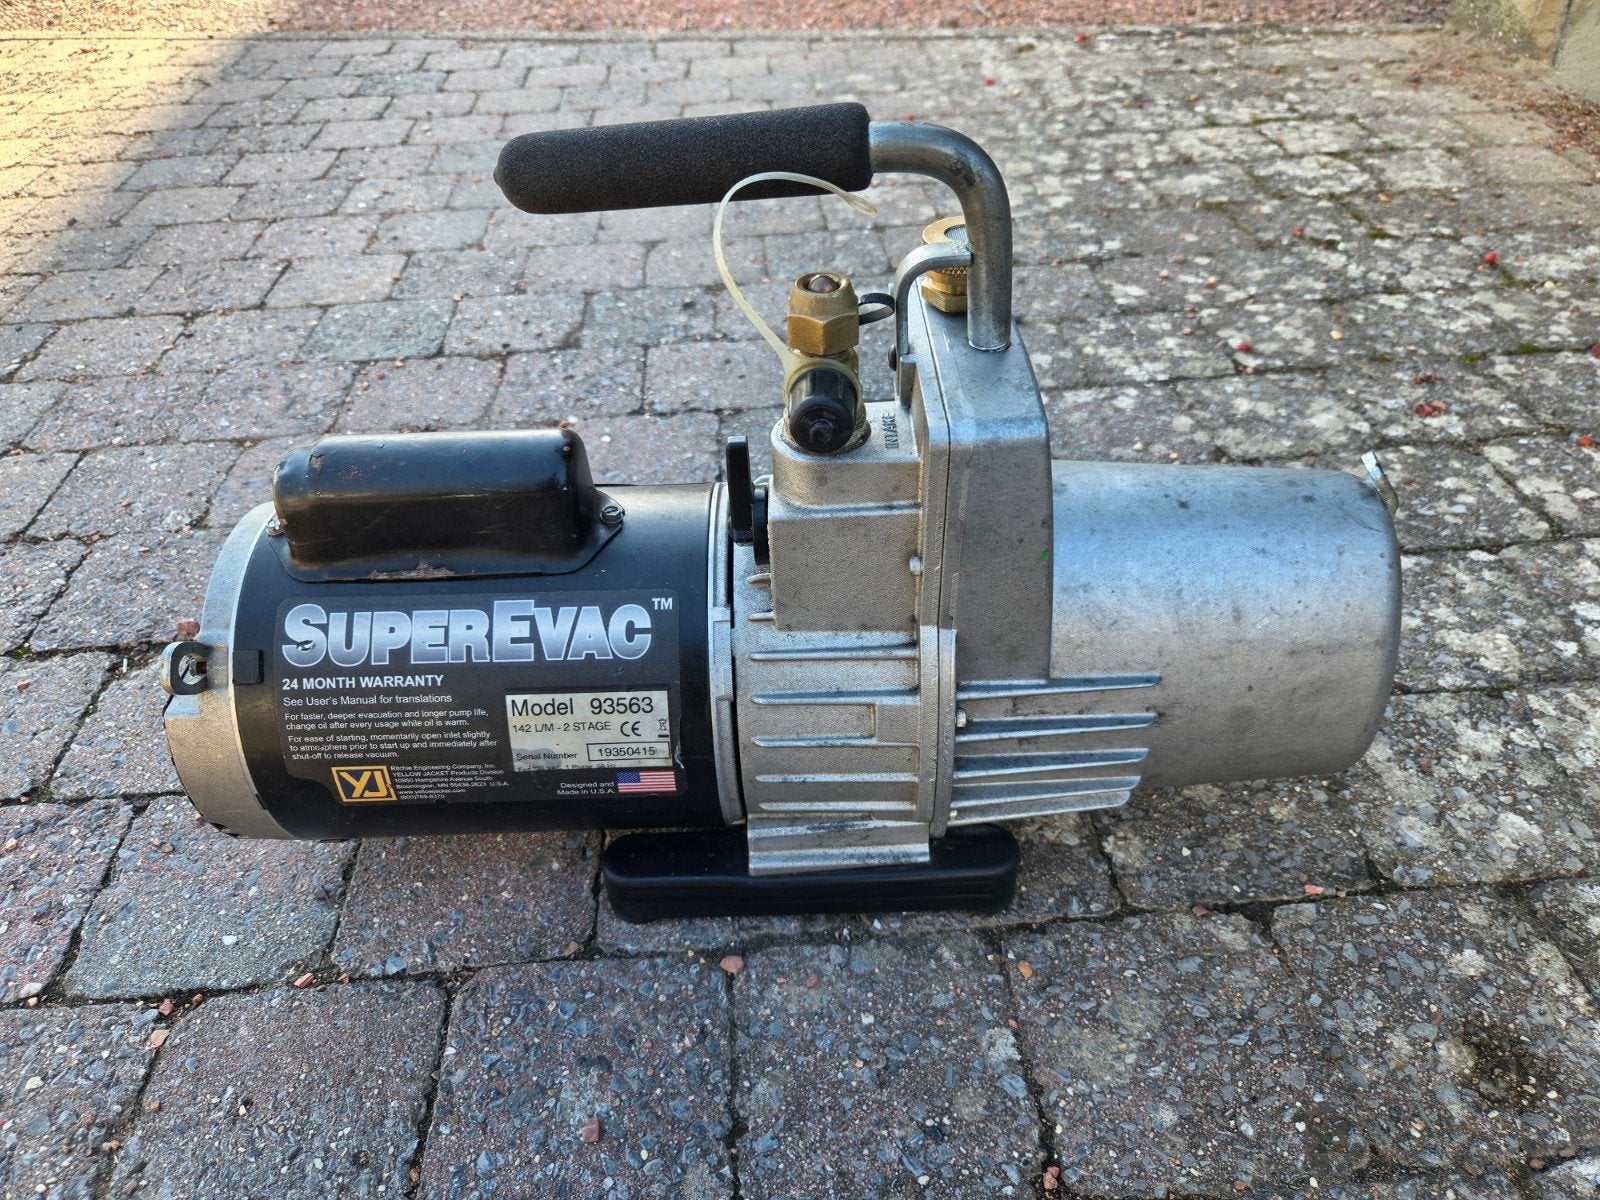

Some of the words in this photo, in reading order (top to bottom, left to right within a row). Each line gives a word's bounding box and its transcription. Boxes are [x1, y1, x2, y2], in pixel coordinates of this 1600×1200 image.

[281, 678, 299, 691] 24
[302, 677, 356, 690] MONTH
[359, 674, 444, 688] WARRANTY
[283, 697, 303, 707] See
[306, 696, 338, 706] User's
[341, 695, 377, 705] Manual
[379, 694, 393, 704] for
[395, 694, 453, 704] translations
[510, 697, 574, 717] Model
[590, 696, 654, 715] 93563
[285, 713, 299, 721] For
[301, 712, 326, 721] faster,
[328, 712, 356, 721] deeper
[358, 710, 402, 719] evacuation
[405, 710, 419, 718] and
[421, 709, 447, 719] longer
[450, 709, 473, 718] pump
[474, 707, 489, 717] life,
[286, 721, 316, 731] change
[318, 721, 328, 729] oil
[330, 720, 349, 729] after
[350, 721, 373, 730] every
[374, 720, 400, 729] usage
[402, 719, 422, 727] while
[425, 718, 434, 727] oil
[445, 718, 470, 727] warm.
[512, 723, 532, 733] 142
[534, 723, 555, 733] L/M
[563, 722, 571, 732] 2
[572, 721, 612, 732] STAGE
[288, 734, 303, 743] For
[326, 734, 335, 742] of
[336, 734, 370, 743] starting,
[371, 732, 419, 741] momentarily
[421, 733, 442, 741] open
[444, 731, 461, 740] inlet
[462, 730, 491, 740] slightly
[290, 744, 299, 752] to
[350, 742, 369, 751] prior
[370, 742, 379, 750] to
[380, 742, 399, 750] start
[400, 742, 411, 750] up
[413, 741, 428, 749] and
[429, 740, 478, 749] immediately
[479, 739, 498, 747] after
[597, 746, 656, 757] 19350415
[292, 752, 322, 761] shut-off
[324, 751, 333, 760] to
[334, 751, 364, 759] release
[365, 750, 400, 759] vacuum.
[516, 753, 541, 761] Serial
[543, 752, 578, 761] Number
[560, 781, 598, 790] Designed
